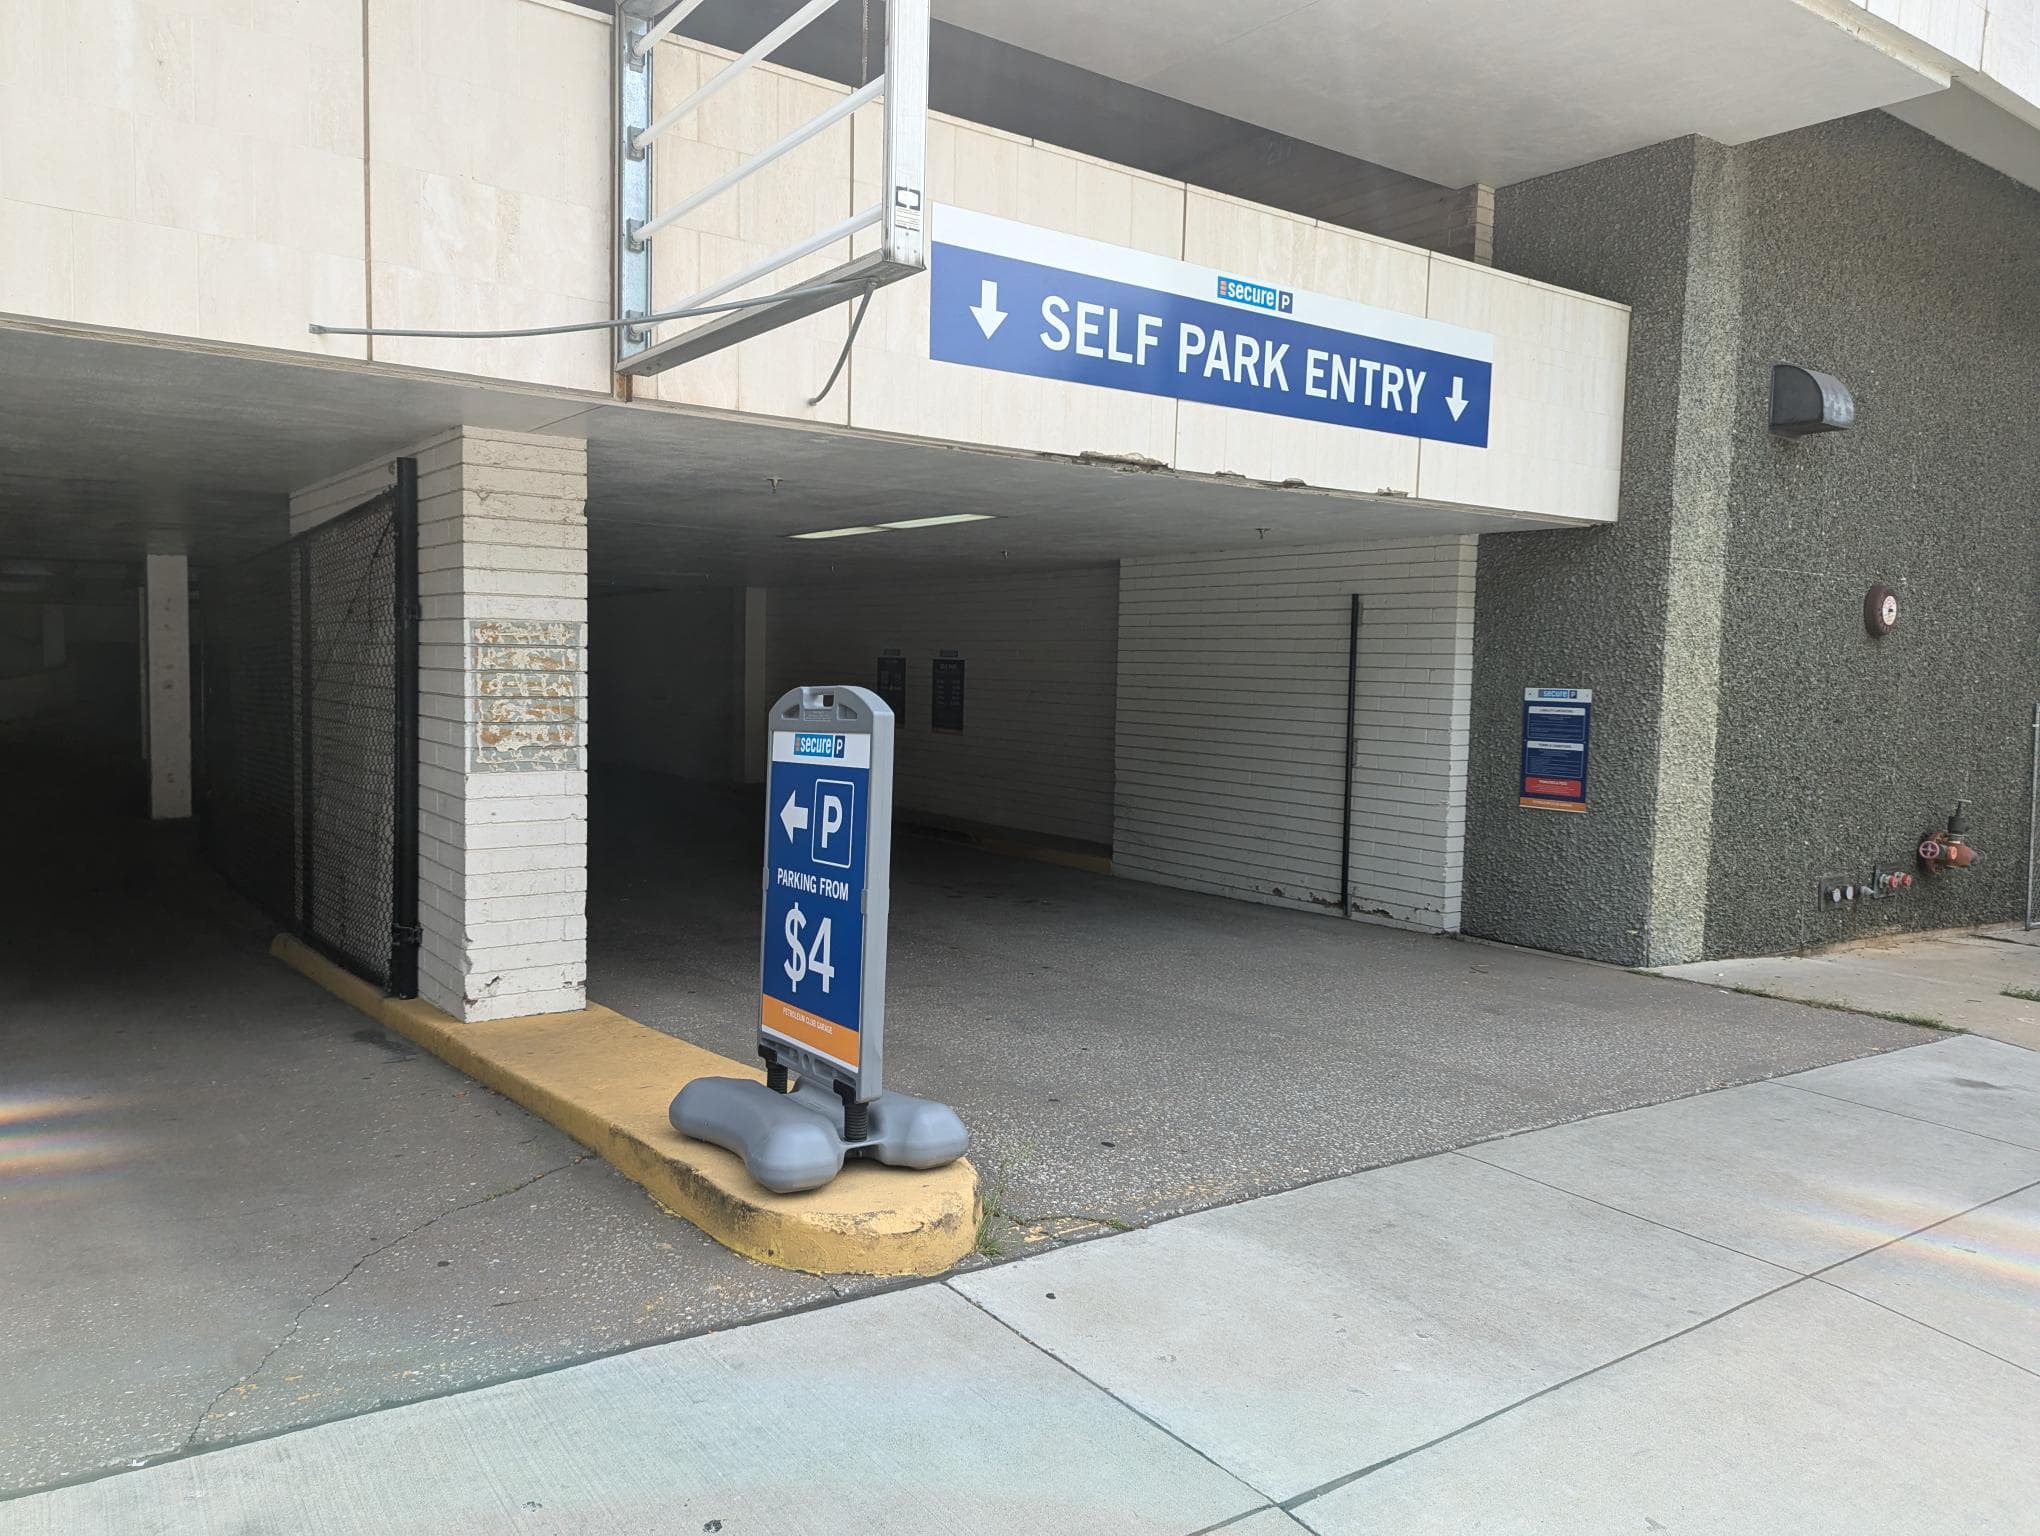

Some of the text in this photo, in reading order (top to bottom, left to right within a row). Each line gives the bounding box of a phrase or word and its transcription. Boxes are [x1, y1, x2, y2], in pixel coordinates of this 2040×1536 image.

[1228, 282, 1290, 309] secure P
[1040, 295, 1427, 414] SELF PARK ENTRY
[800, 736, 843, 755] secure P
[822, 794, 843, 849] P
[777, 867, 849, 901] PARKING FROM
[784, 902, 835, 994] $4
[783, 1007, 833, 1035] PETROLEUM CLUB GARAGE
